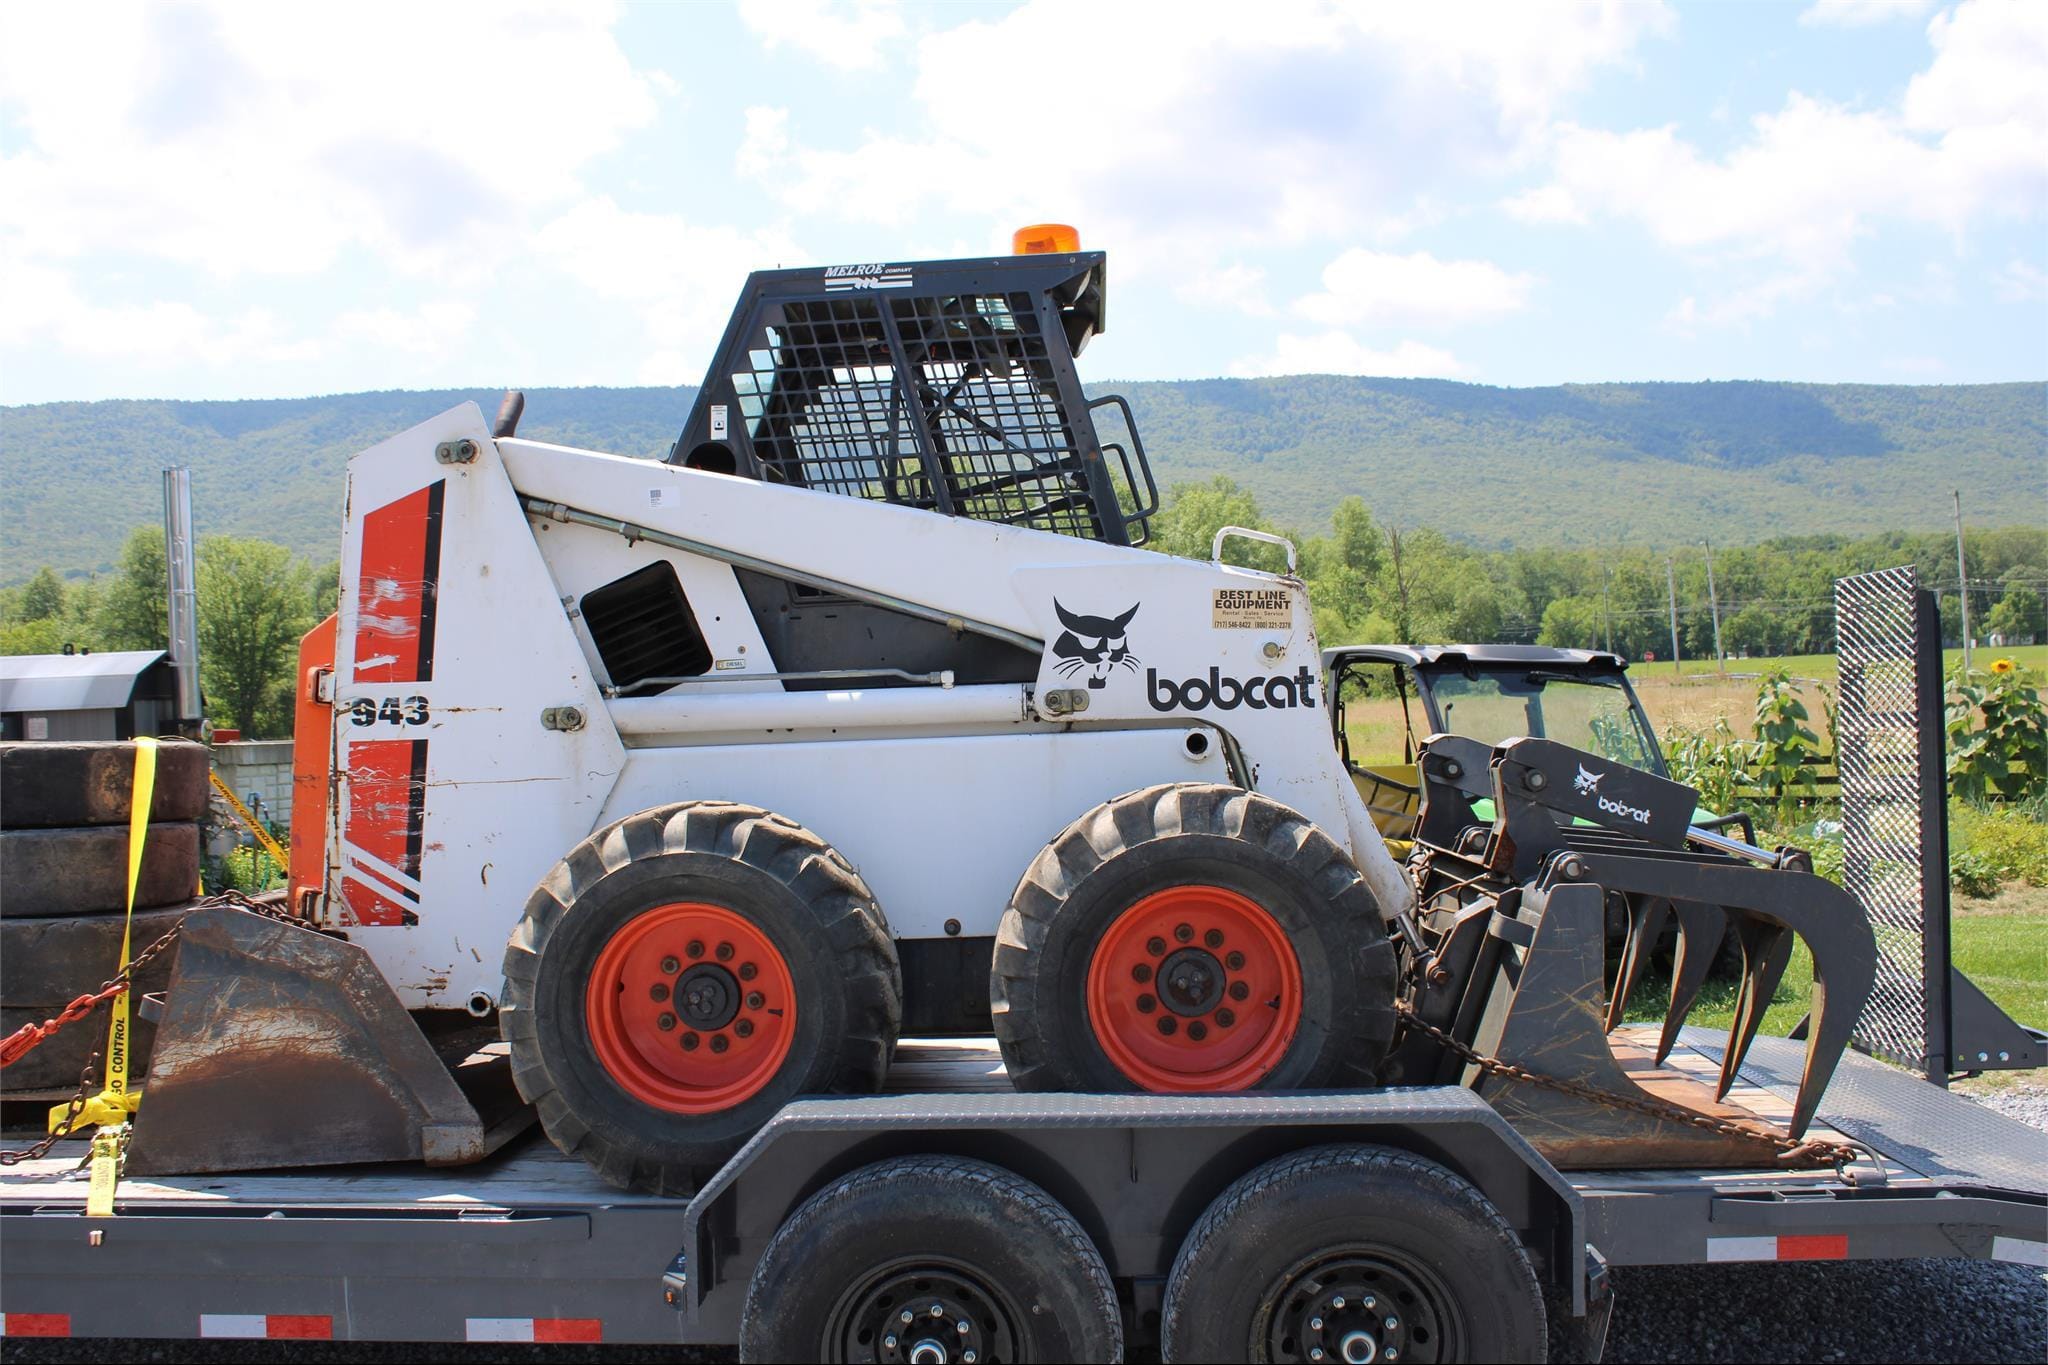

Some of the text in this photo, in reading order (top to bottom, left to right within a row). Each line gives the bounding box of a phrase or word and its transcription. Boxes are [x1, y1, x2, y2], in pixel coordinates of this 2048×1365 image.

[825, 264, 885, 277] MELROE
[1215, 600, 1291, 609] EQUIPMENT
[1220, 590, 1286, 600] BEST LINE
[1147, 666, 1315, 712] bobcat
[351, 696, 430, 727] 943
[213, 778, 273, 845] CARGO CONTROL
[112, 1017, 125, 1074] CONTROL
